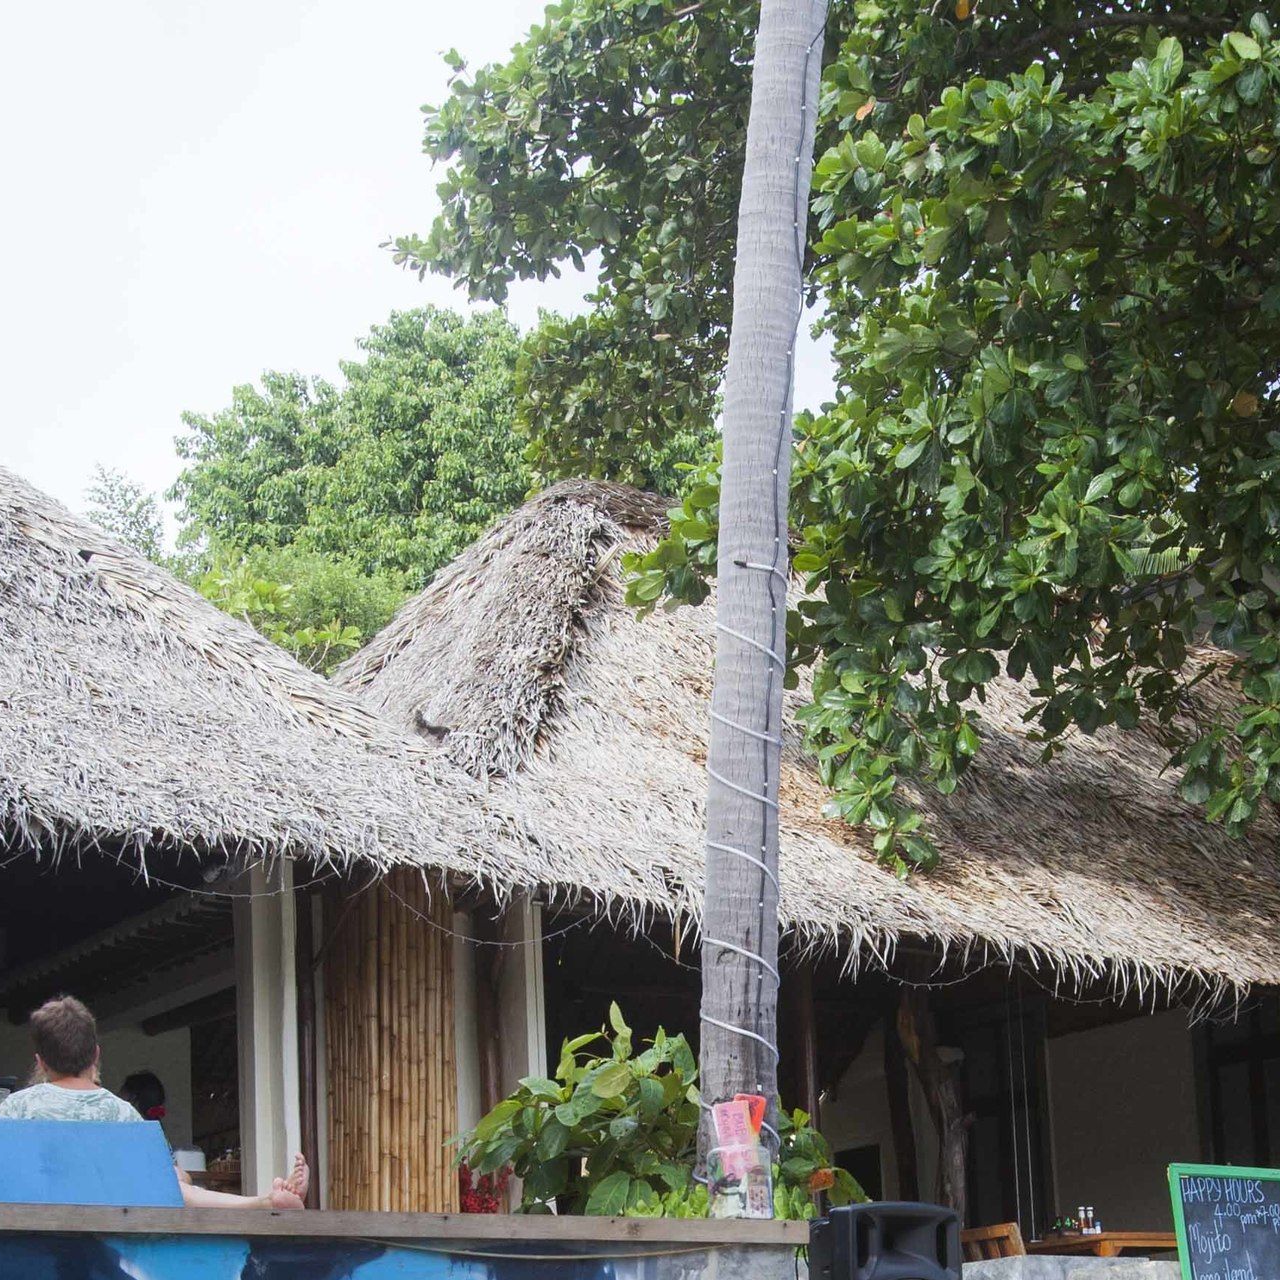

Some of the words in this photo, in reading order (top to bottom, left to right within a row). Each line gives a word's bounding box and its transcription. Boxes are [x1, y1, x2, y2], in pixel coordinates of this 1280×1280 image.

[1181, 1177, 1221, 1203] HAPPY
[1224, 1178, 1265, 1204] HOURS
[1188, 1219, 1231, 1264] Mojito
